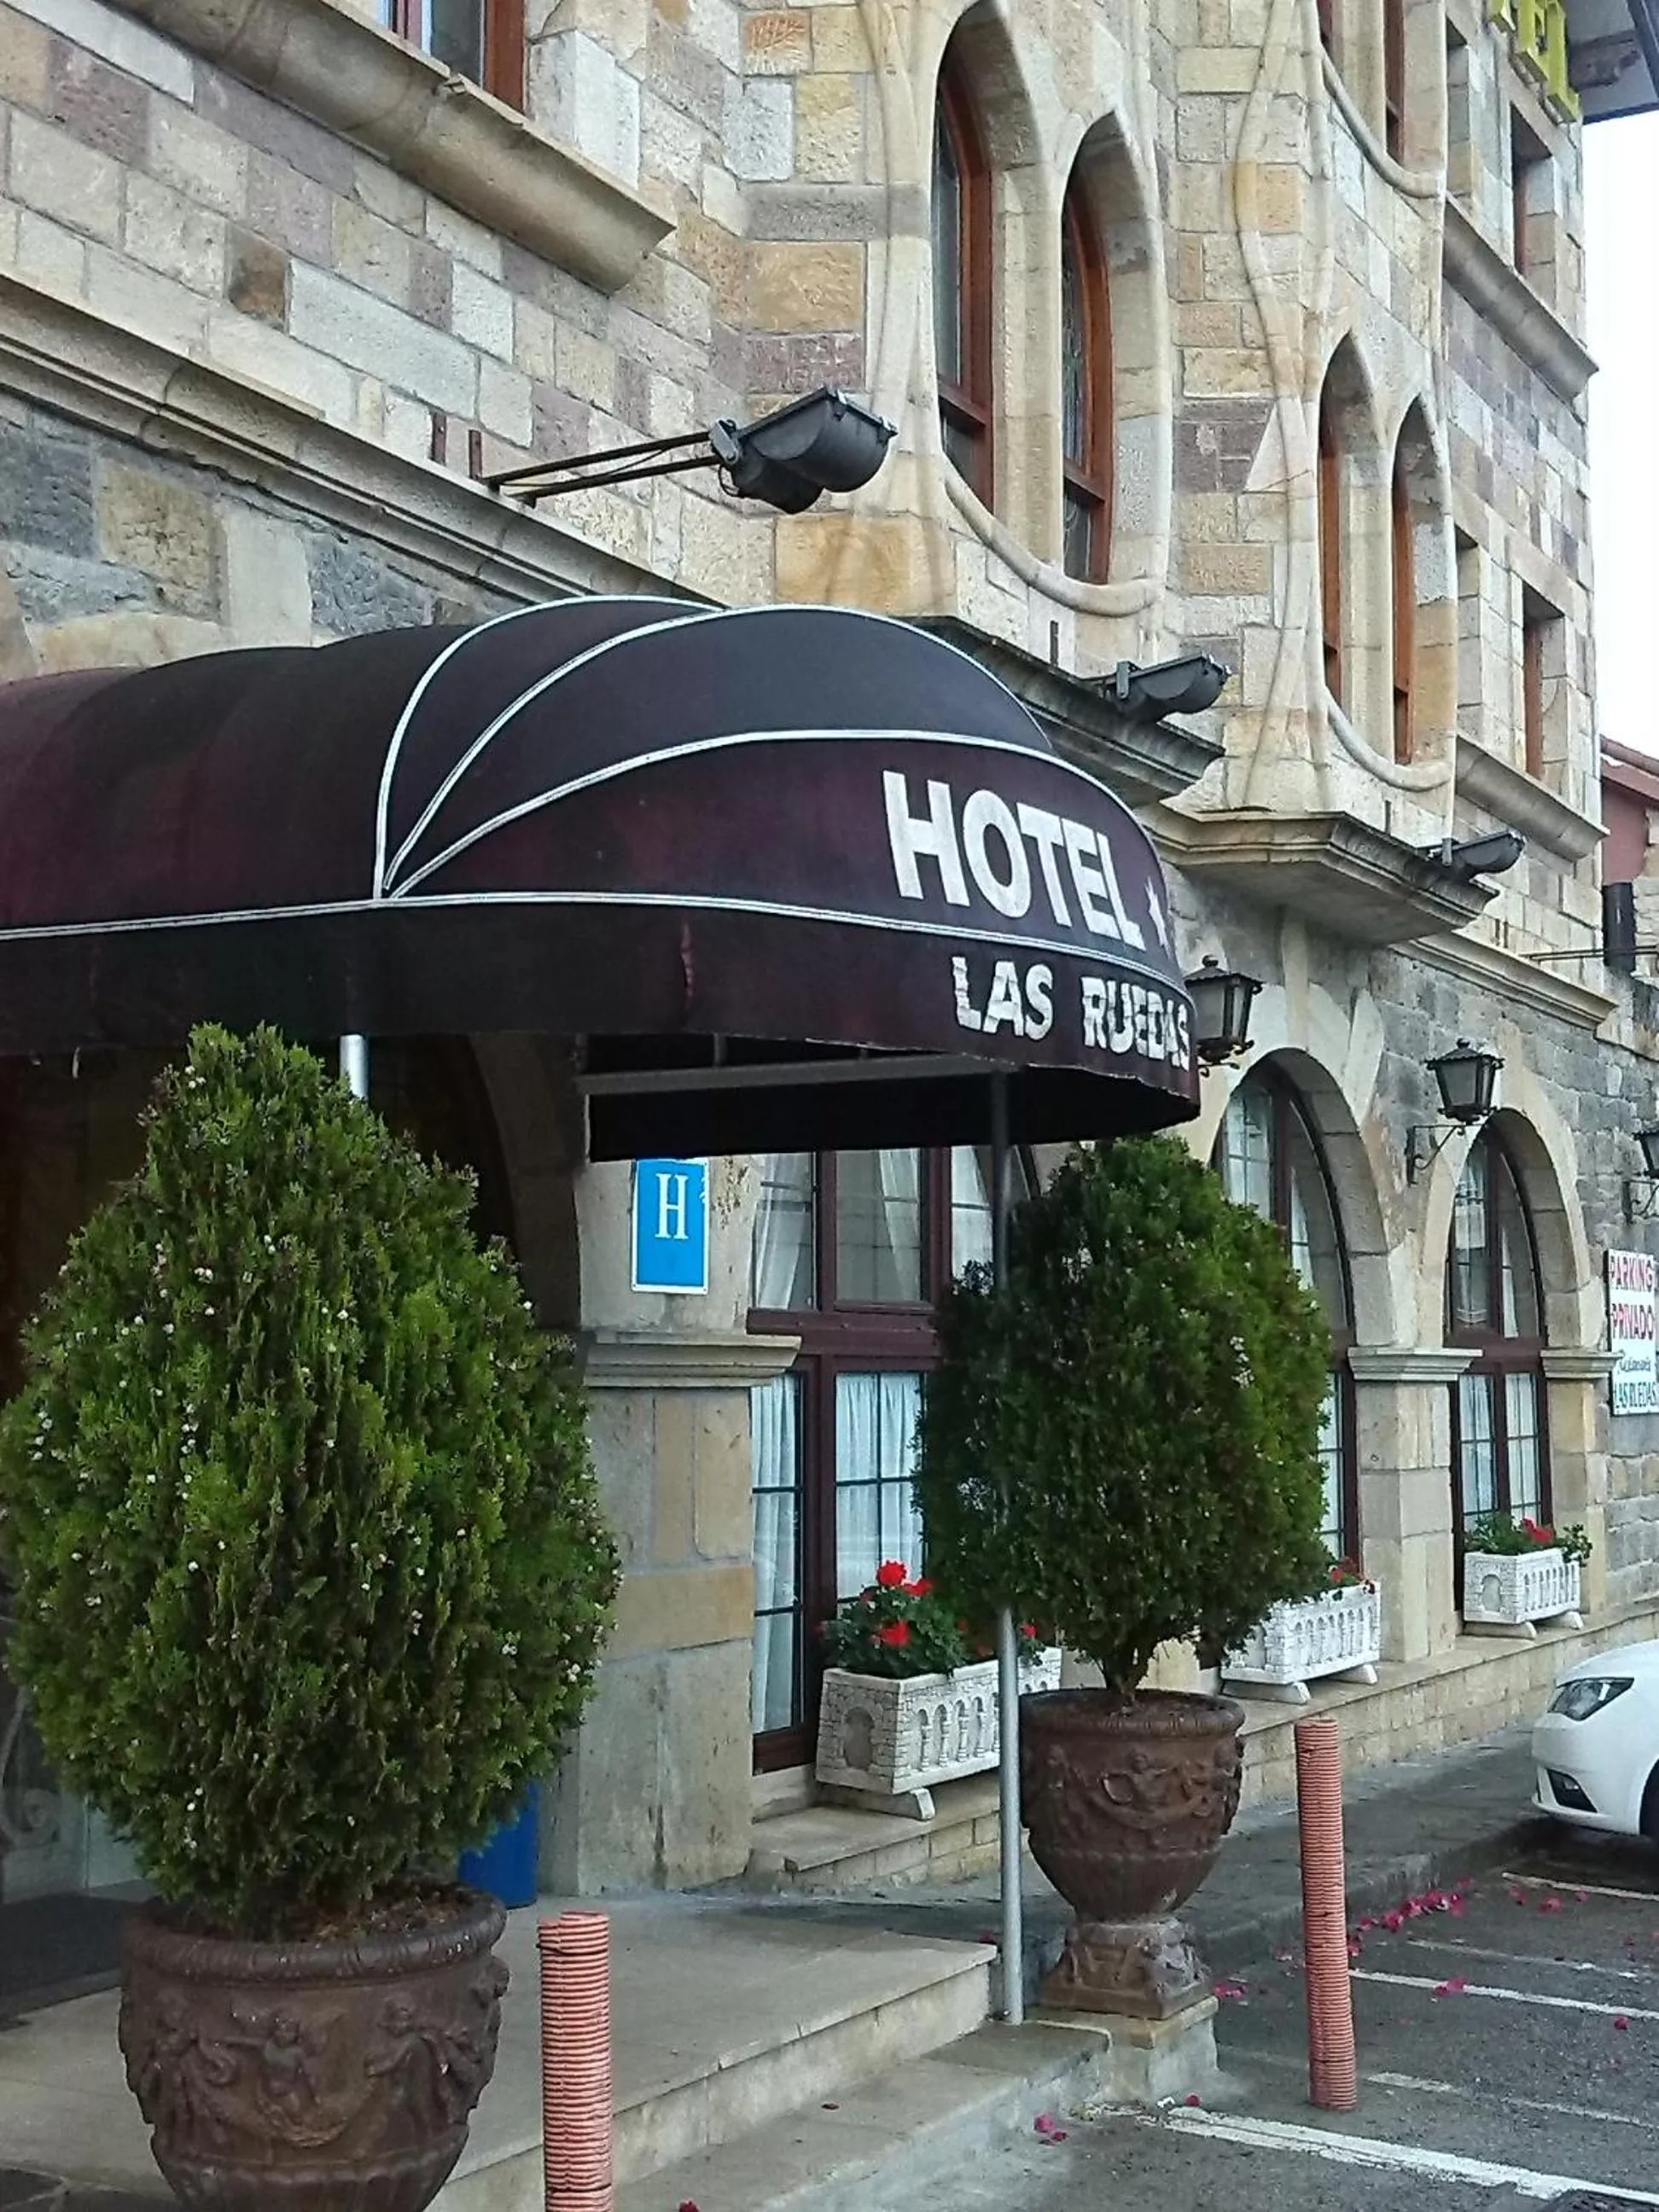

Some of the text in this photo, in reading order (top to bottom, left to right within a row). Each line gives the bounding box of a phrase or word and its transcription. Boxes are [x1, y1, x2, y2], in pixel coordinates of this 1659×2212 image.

[882, 770, 1146, 951] HOTEL
[952, 957, 1190, 1072] LAS RUEDAS
[655, 1173, 689, 1240] H
[1610, 1255, 1653, 1292] PARKING
[1611, 1303, 1655, 1341] PRIVADO
